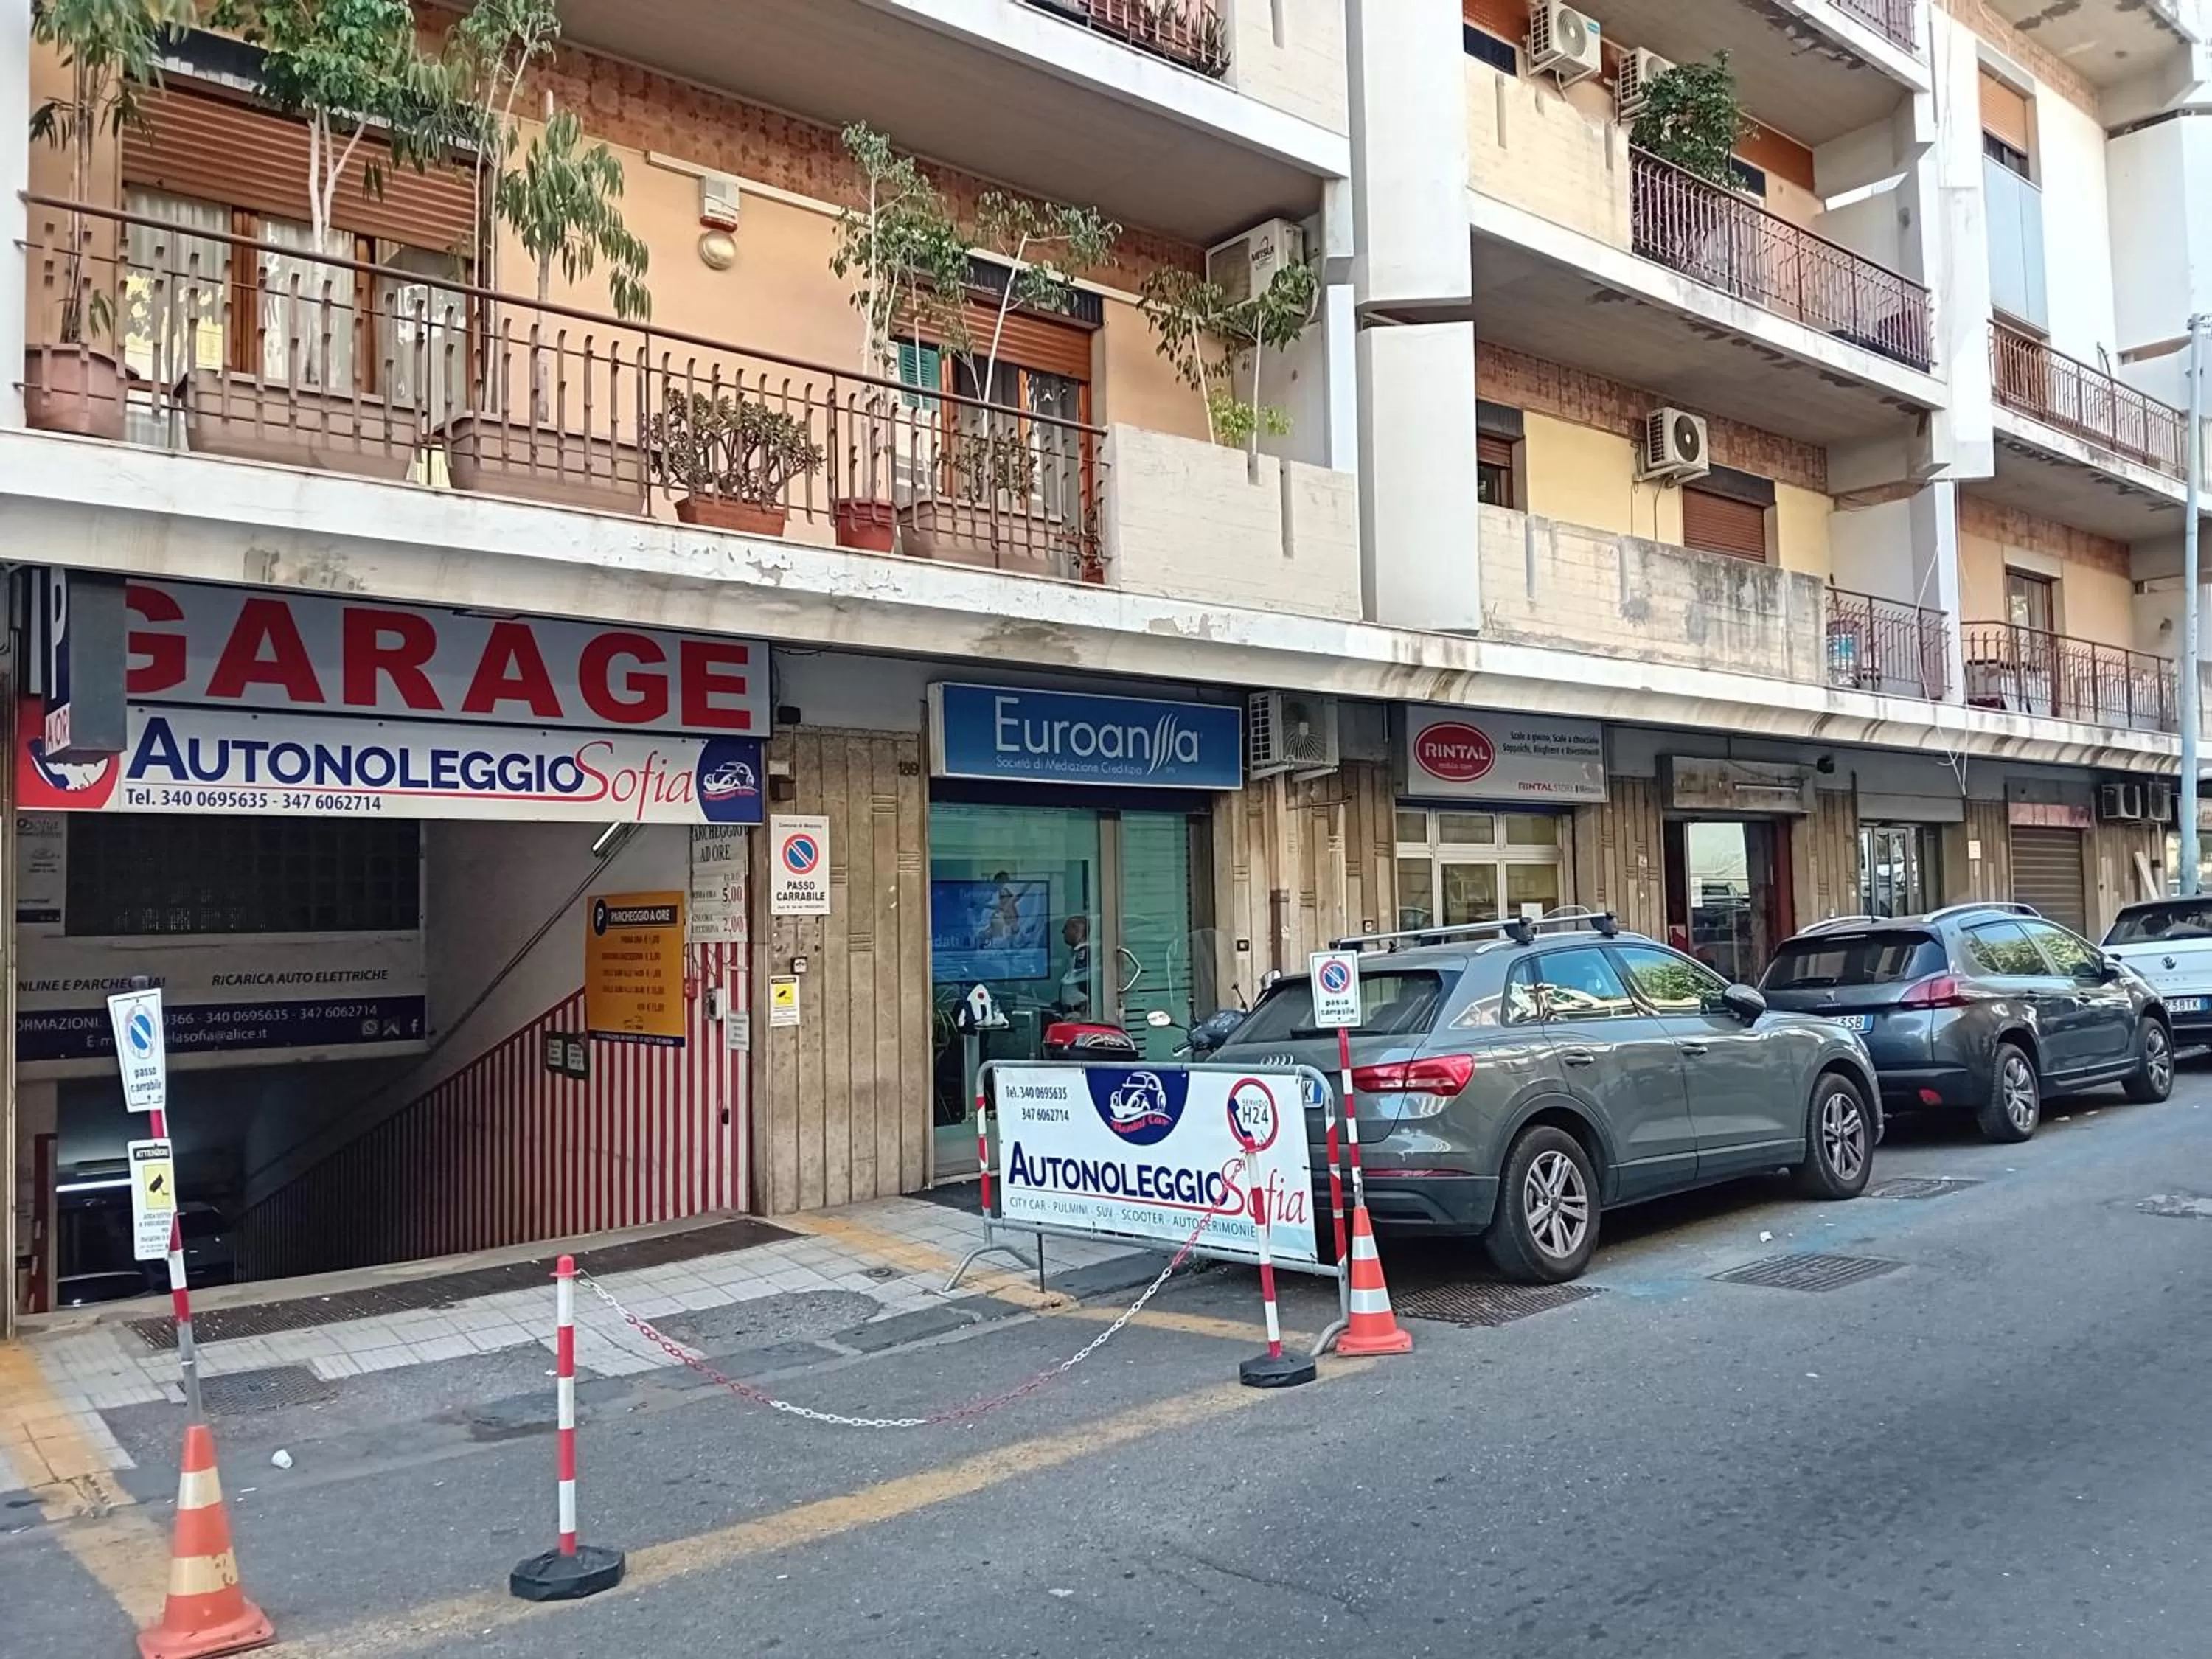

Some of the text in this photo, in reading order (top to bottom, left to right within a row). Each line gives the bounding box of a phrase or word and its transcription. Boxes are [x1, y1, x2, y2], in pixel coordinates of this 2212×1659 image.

[125, 584, 751, 729] GARAGE
[1425, 742, 1489, 760] RINTAL
[126, 717, 694, 820] AUTONOLEGGIO Sofia
[1045, 759, 1099, 773] Mediazione
[126, 788, 156, 806] Tel.
[161, 789, 192, 807] 340
[196, 791, 268, 808] 0695635
[282, 793, 311, 810] 347
[315, 794, 381, 810] 6062714
[787, 881, 815, 891] PASSO
[776, 891, 826, 902] CARRABILE
[212, 972, 274, 987] RICARICA
[276, 971, 313, 984] AUTO
[315, 970, 389, 984] ELETTRICHE
[206, 1011, 230, 1023] 340
[324, 1004, 378, 1018] 6062714
[134, 1066, 157, 1079] passo
[131, 1079, 162, 1092] carrabile
[1006, 1085, 1068, 1100] Tel. 340 0695635
[1021, 1107, 1070, 1121] 347 6062714
[1242, 1106, 1269, 1124] H24
[1008, 1141, 1229, 1207] AUTONOLEGGIO
[1009, 1197, 1027, 1208] CITY
[1029, 1199, 1046, 1211] CAR
[1053, 1201, 1089, 1216] PULMINI
[1121, 1207, 1164, 1225] SCOOTER
